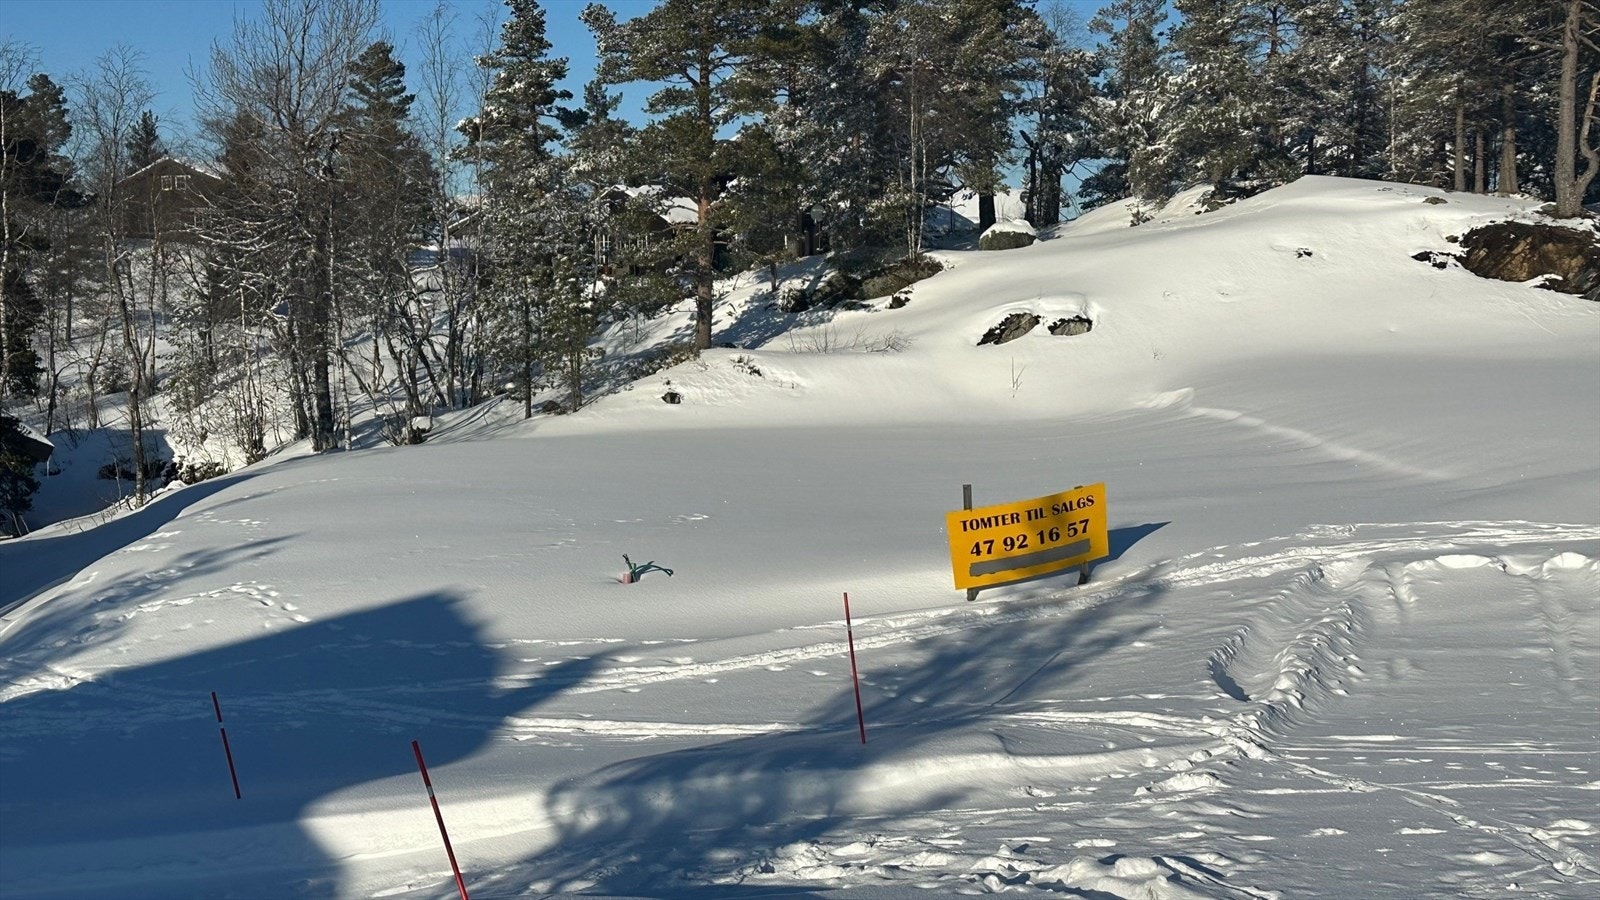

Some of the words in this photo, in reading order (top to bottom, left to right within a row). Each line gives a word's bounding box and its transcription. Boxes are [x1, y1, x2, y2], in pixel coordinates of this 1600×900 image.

[960, 512, 1021, 532] TOMTER
[1025, 508, 1047, 522] TIL
[1052, 495, 1095, 516] SALGS
[970, 539, 995, 556] 47
[1003, 534, 1029, 552] 92
[1037, 527, 1060, 545] 16
[1067, 518, 1090, 538] 57
